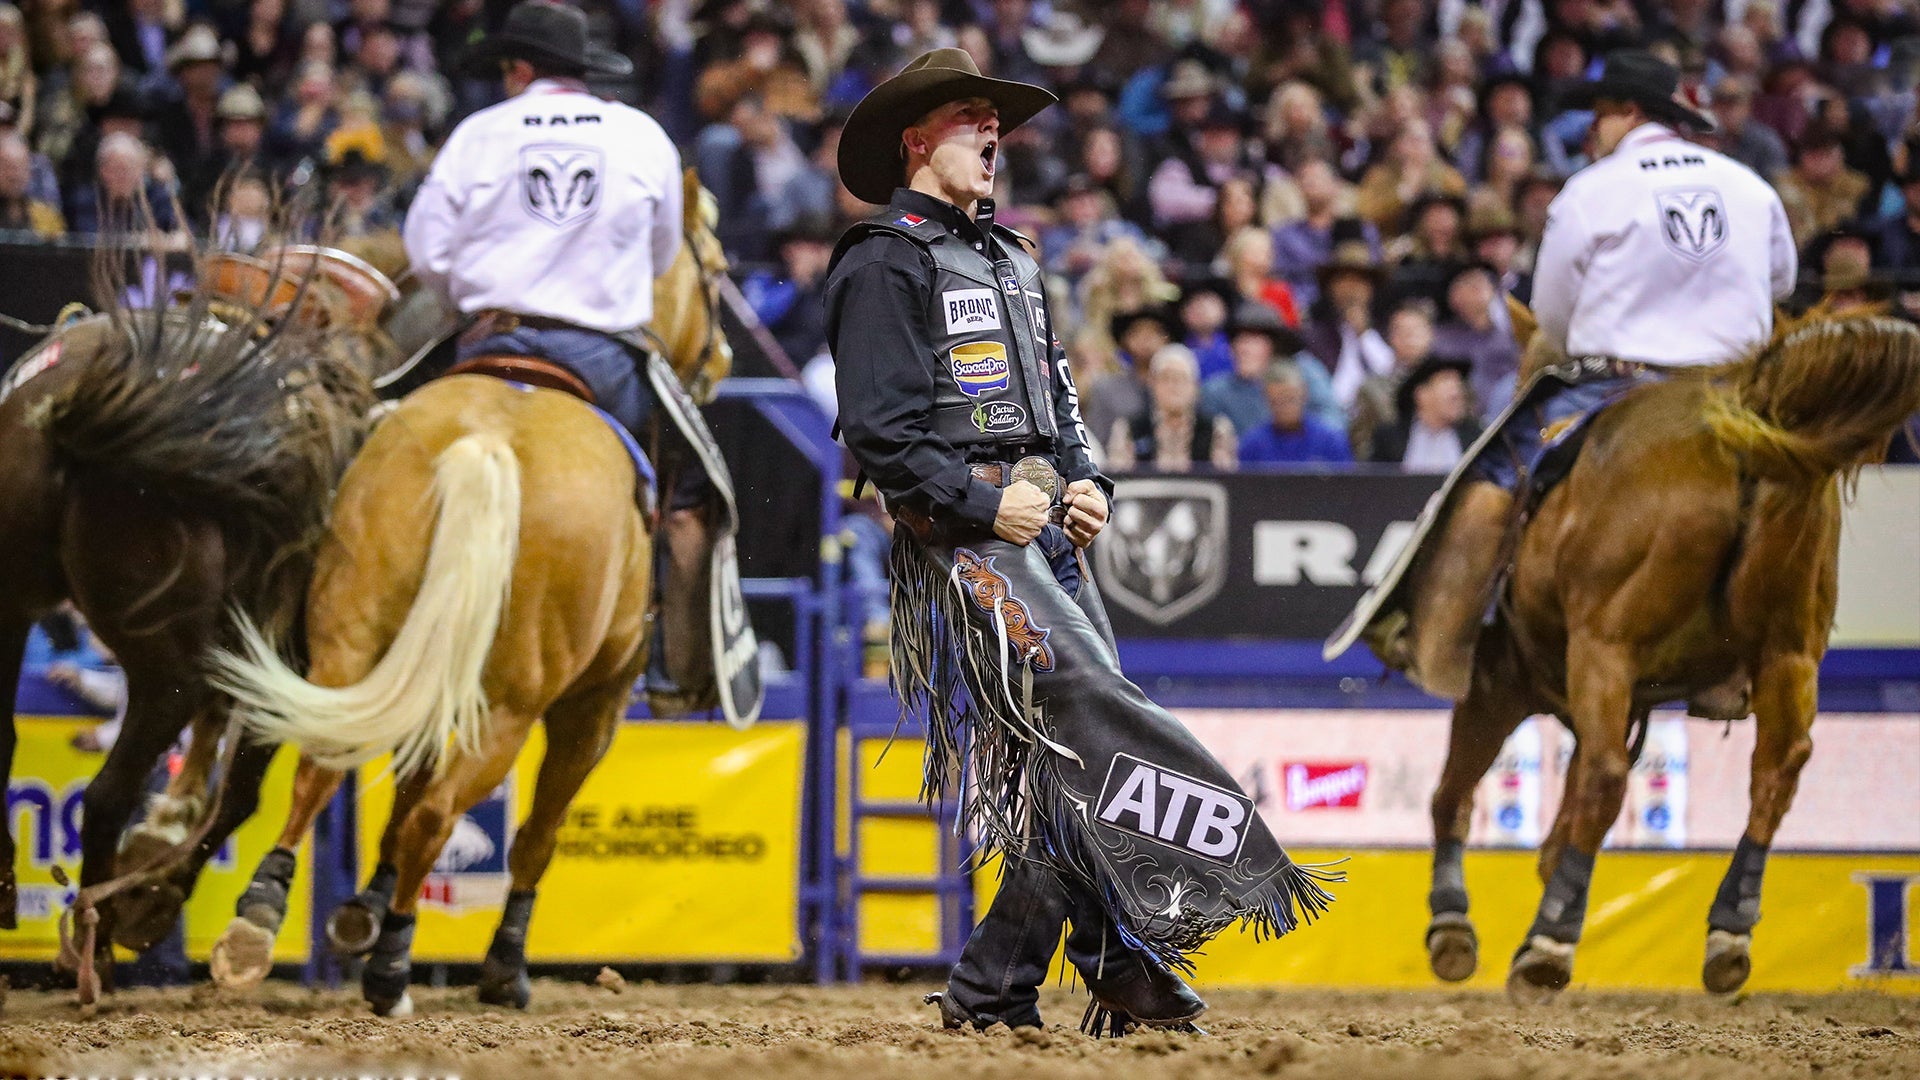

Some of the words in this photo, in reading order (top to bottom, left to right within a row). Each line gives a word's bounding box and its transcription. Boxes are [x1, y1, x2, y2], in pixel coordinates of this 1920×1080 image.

[523, 114, 602, 126] RAM
[948, 298, 996, 325] BRONC
[966, 315, 984, 325] BEER
[954, 357, 1007, 376] SweetPro
[990, 404, 1016, 415] Cactus
[986, 414, 1020, 427] Saddlery
[1099, 763, 1246, 858] ATB
